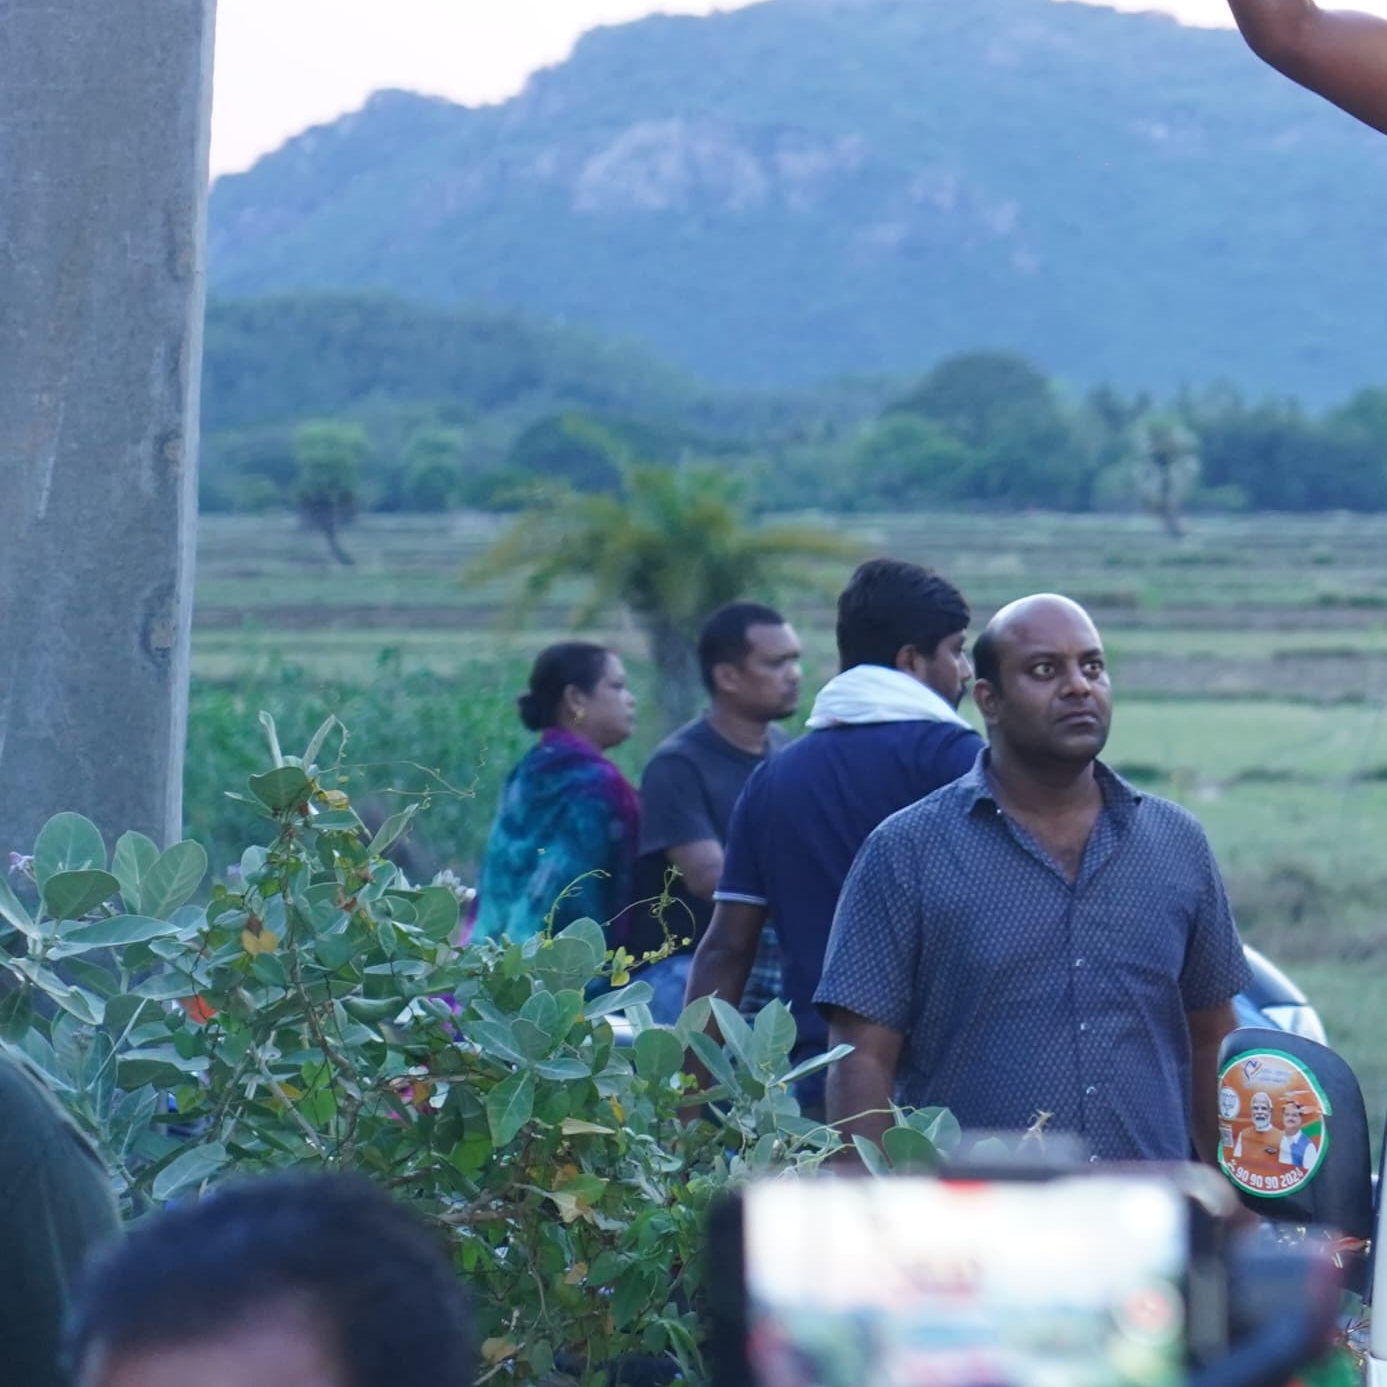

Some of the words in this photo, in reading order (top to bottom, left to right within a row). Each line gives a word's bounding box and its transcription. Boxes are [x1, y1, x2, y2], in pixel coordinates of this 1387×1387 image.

[1236, 1166, 1249, 1182] 90
[1250, 1174, 1263, 1187] 90
[1264, 1176, 1279, 1189] 90
